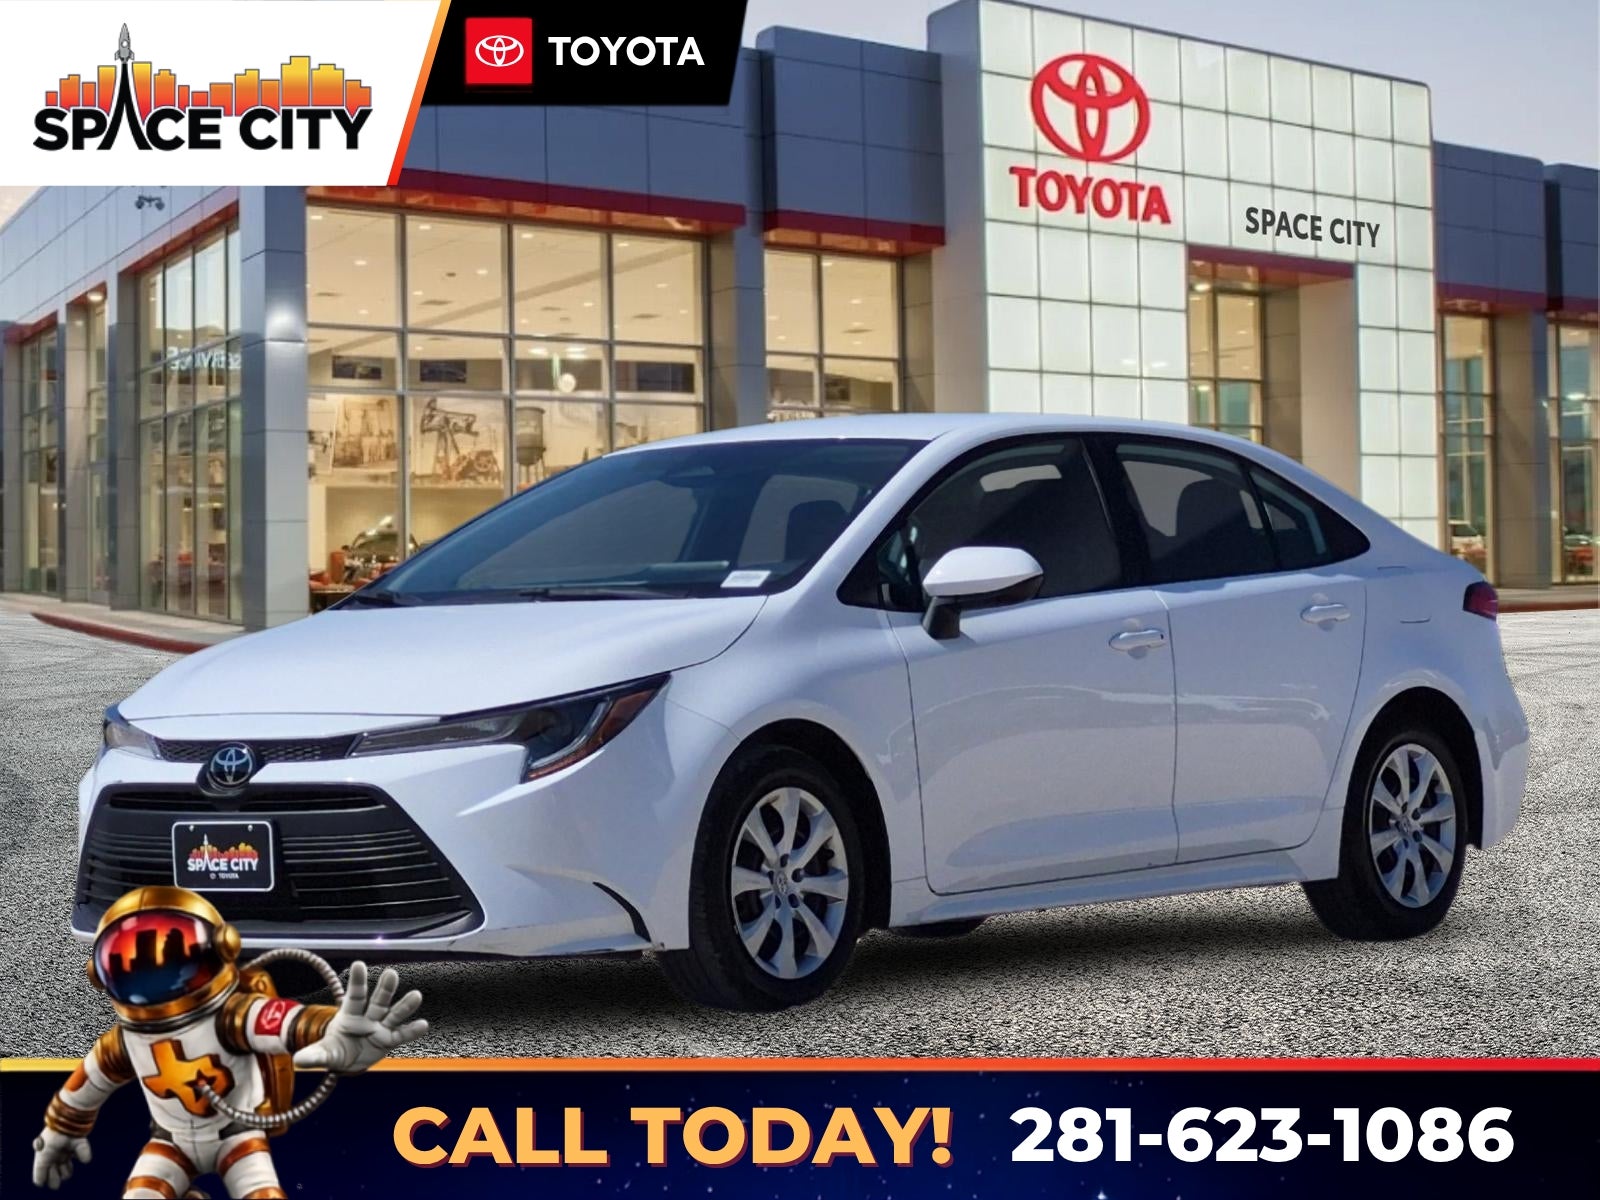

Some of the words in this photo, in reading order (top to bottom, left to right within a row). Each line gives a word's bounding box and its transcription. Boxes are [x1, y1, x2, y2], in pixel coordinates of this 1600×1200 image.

[1009, 166, 1171, 225] TOYOTA
[1244, 205, 1323, 242] SPACE
[1328, 217, 1381, 248] CITY
[187, 858, 228, 871] SPACE
[230, 858, 259, 871] CITY
